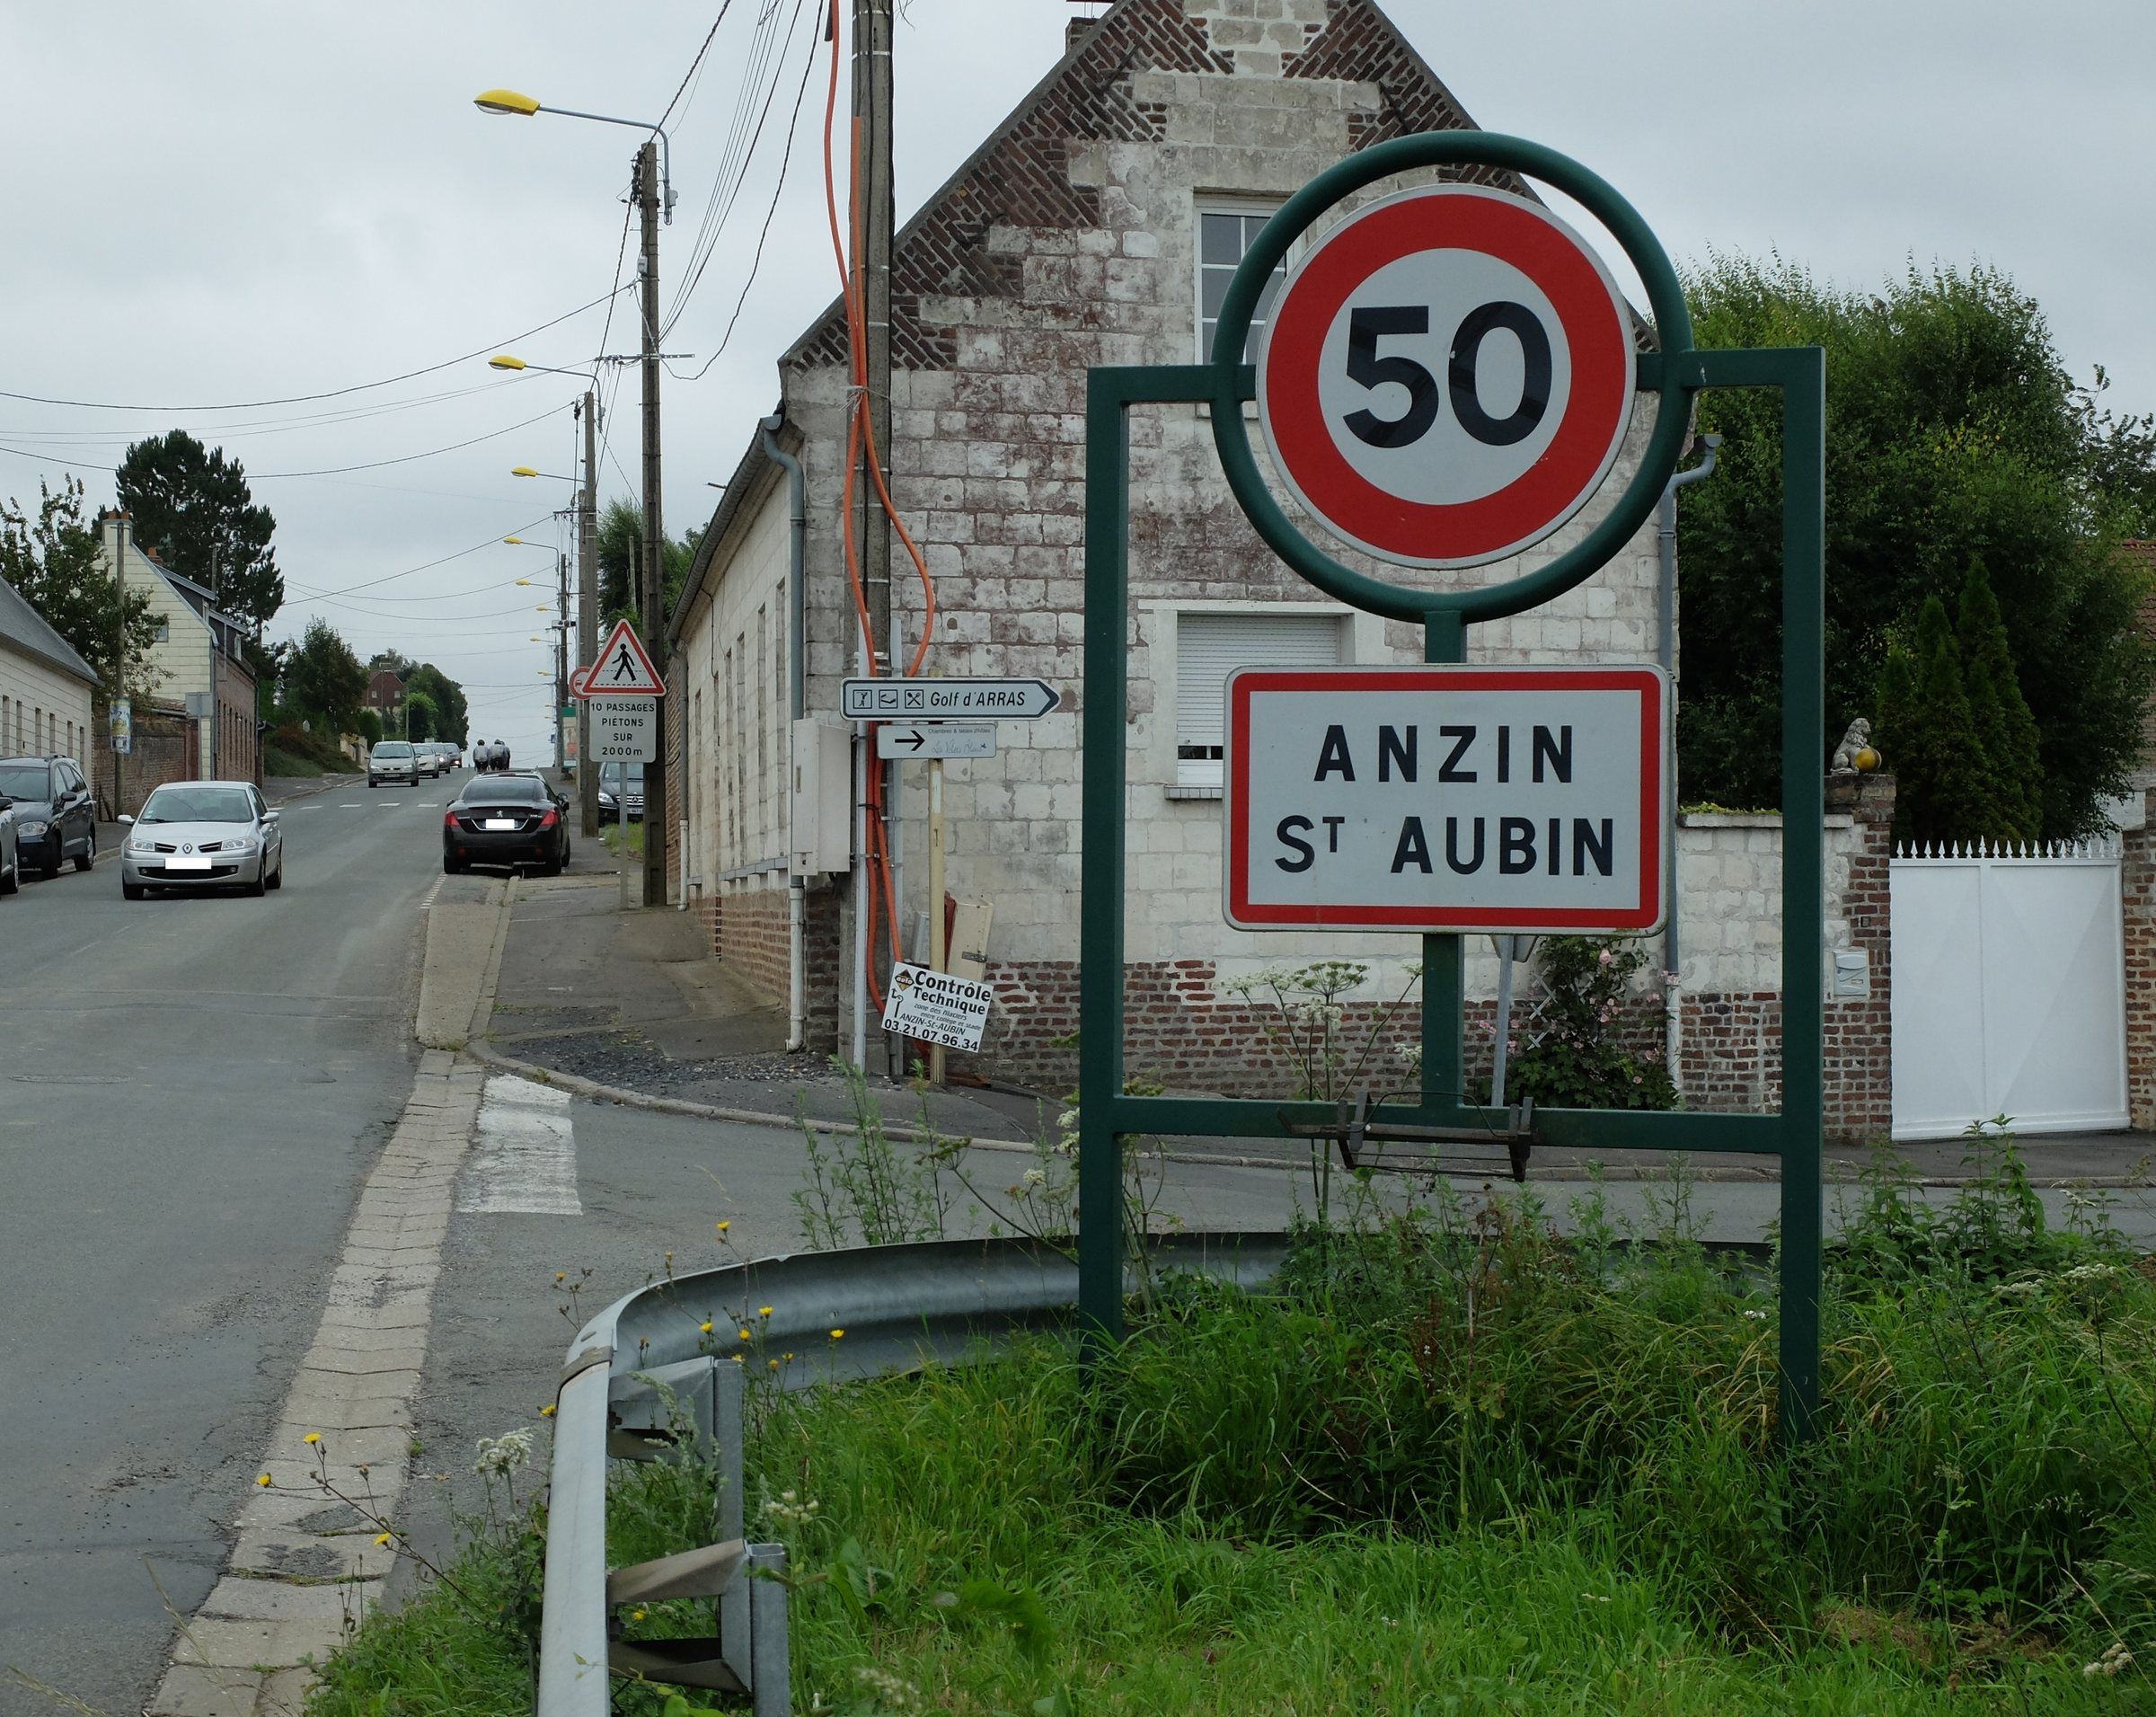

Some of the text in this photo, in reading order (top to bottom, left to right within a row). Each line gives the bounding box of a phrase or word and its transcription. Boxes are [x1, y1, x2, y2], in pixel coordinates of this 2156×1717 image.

[1342, 300, 1553, 448] 50
[591, 703, 655, 712] 10 PASSAGES
[930, 691, 1026, 707] Golf d'ARRAS
[601, 715, 644, 727] PIÉTONS
[613, 732, 633, 741] SUR
[601, 747, 643, 756] 2000m
[1312, 724, 1573, 783] ANZIN
[1390, 816, 1613, 877] AUBIN
[915, 970, 991, 1002] Contrôle
[913, 986, 985, 1015] Technique
[914, 1003, 929, 1013] zone
[929, 1006, 941, 1015] des
[884, 1018, 978, 1051] 03.21.07.96.34
[899, 1013, 966, 1036] ANZIN-St-AUBIN
